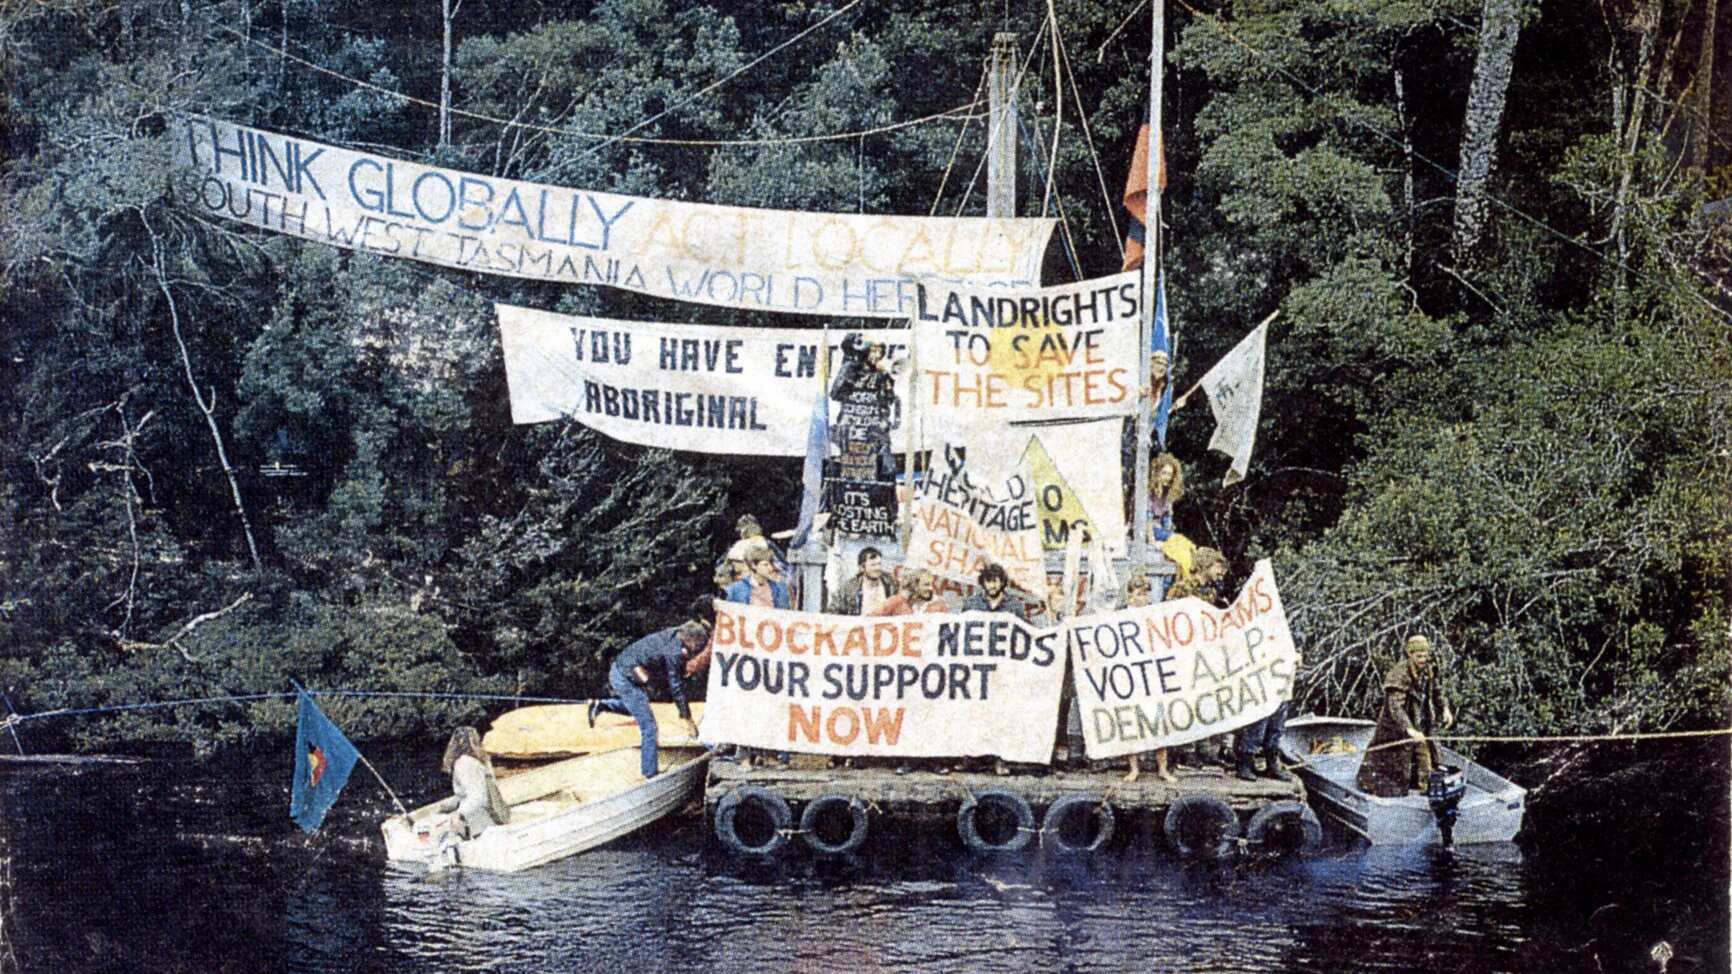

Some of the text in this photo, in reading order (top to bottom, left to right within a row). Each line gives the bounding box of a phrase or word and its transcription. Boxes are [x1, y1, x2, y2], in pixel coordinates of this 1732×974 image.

[175, 113, 1027, 274] THINK GLOBALLY ACT LOCALLY
[326, 206, 436, 258] WEST
[447, 233, 647, 288] TASMANIA
[666, 264, 824, 309] WORLD
[916, 282, 1138, 328] LANDRIGHTS
[571, 326, 633, 365] YOU
[660, 336, 744, 374] HAVE
[946, 329, 1105, 369] TO SAVE
[584, 378, 768, 431] ABORIGINAL
[925, 369, 1008, 409] THE
[1023, 367, 1128, 409] SITES
[714, 611, 1057, 667] BLOCKADE NEEDS
[1074, 621, 1144, 661] FOR
[1146, 611, 1194, 652] NO
[715, 651, 998, 701] YOUR SUPPORT
[1085, 655, 1182, 702] VOTE
[1093, 658, 1292, 744] DEMOCRATS
[787, 703, 905, 745] NOW
